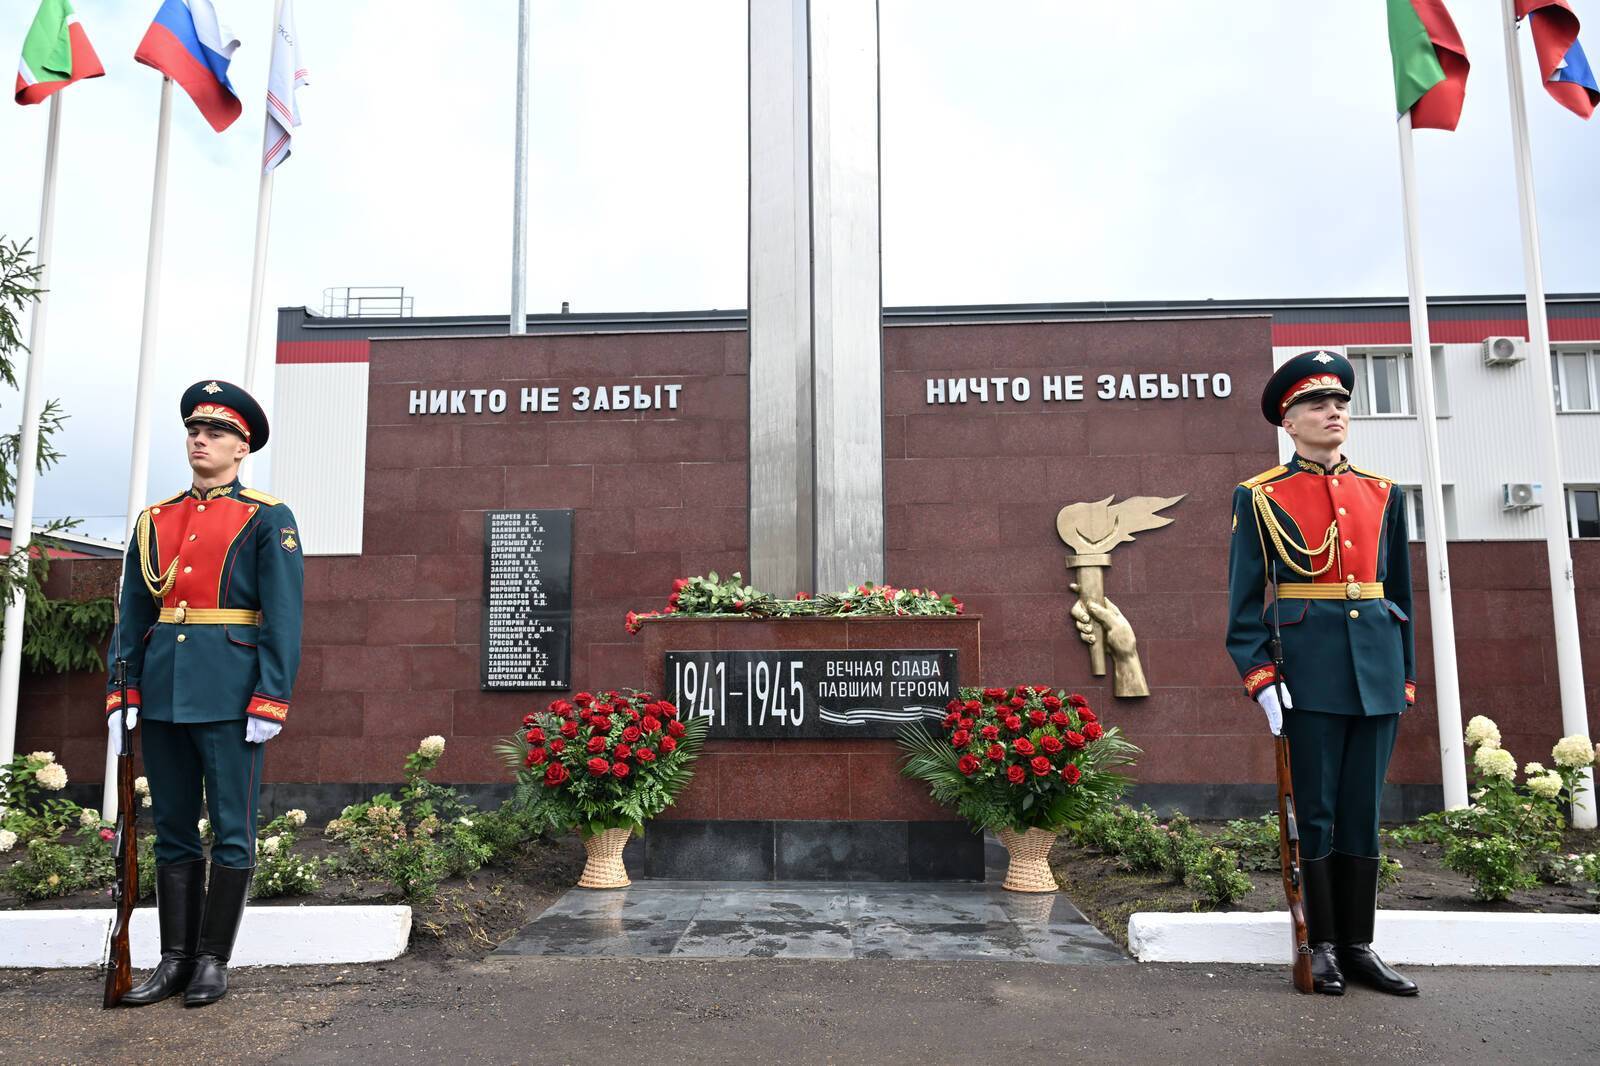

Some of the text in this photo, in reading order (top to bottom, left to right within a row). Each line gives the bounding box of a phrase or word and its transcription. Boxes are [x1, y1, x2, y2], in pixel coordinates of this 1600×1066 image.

[408, 384, 682, 414] НИКТО НЕ ЗАБЫТ
[926, 373, 1232, 403] НИЧТО НЕ ЗАБЫТО
[826, 660, 941, 677] ВЕЧНАЯ СЛАВА
[818, 680, 949, 698] ПАВШИМ ГЕРОЯМ
